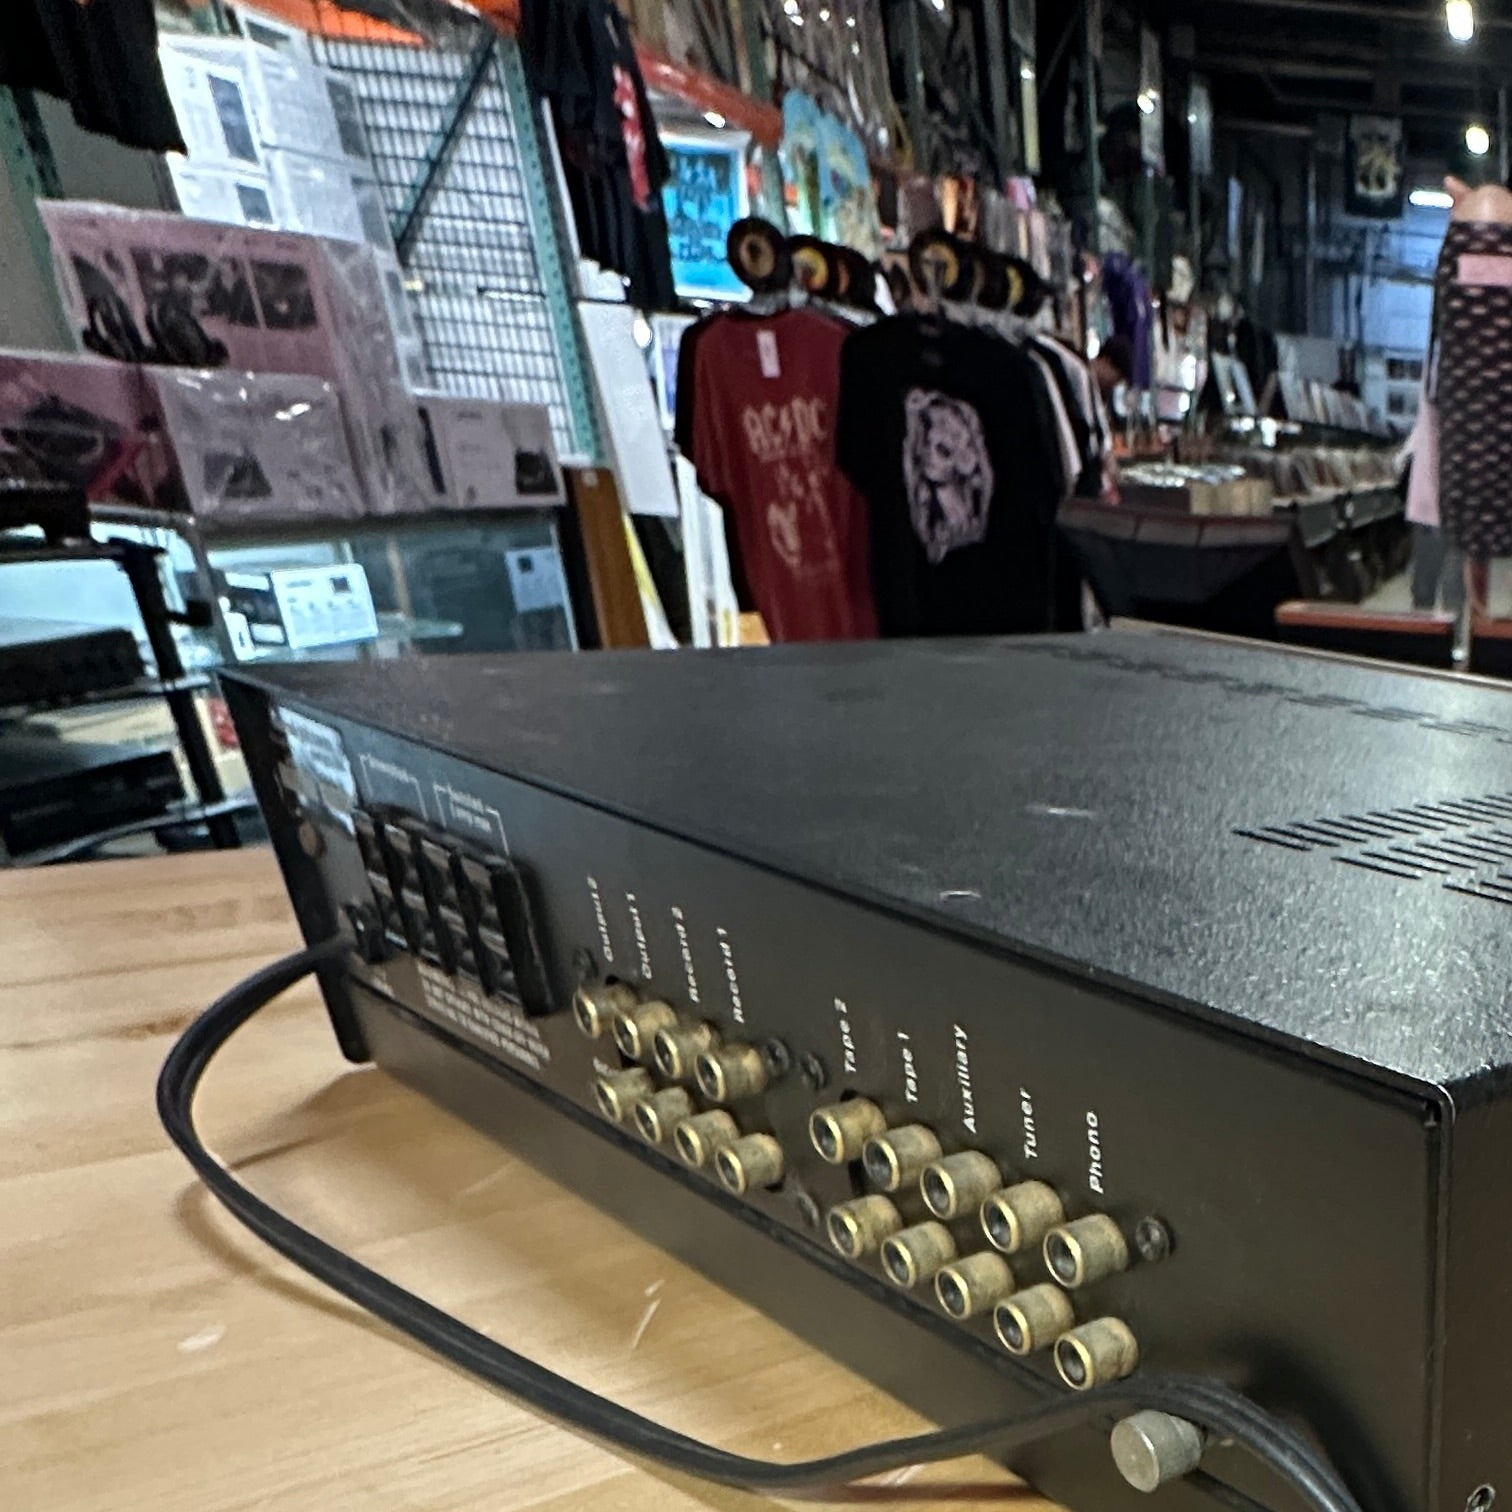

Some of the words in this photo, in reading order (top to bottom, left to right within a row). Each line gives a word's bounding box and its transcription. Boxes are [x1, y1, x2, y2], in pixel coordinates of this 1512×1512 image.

[590, 891, 613, 962] Output
[629, 905, 653, 980] Output
[674, 921, 700, 1003] Record
[719, 940, 745, 1024] Record
[834, 996, 848, 1014] 2
[840, 1018, 857, 1073] Tape
[902, 1047, 918, 1103] Tape
[953, 1023, 977, 1136] Auxiliary
[1019, 1086, 1039, 1159] Tuner
[1085, 1109, 1105, 1195] Phono
